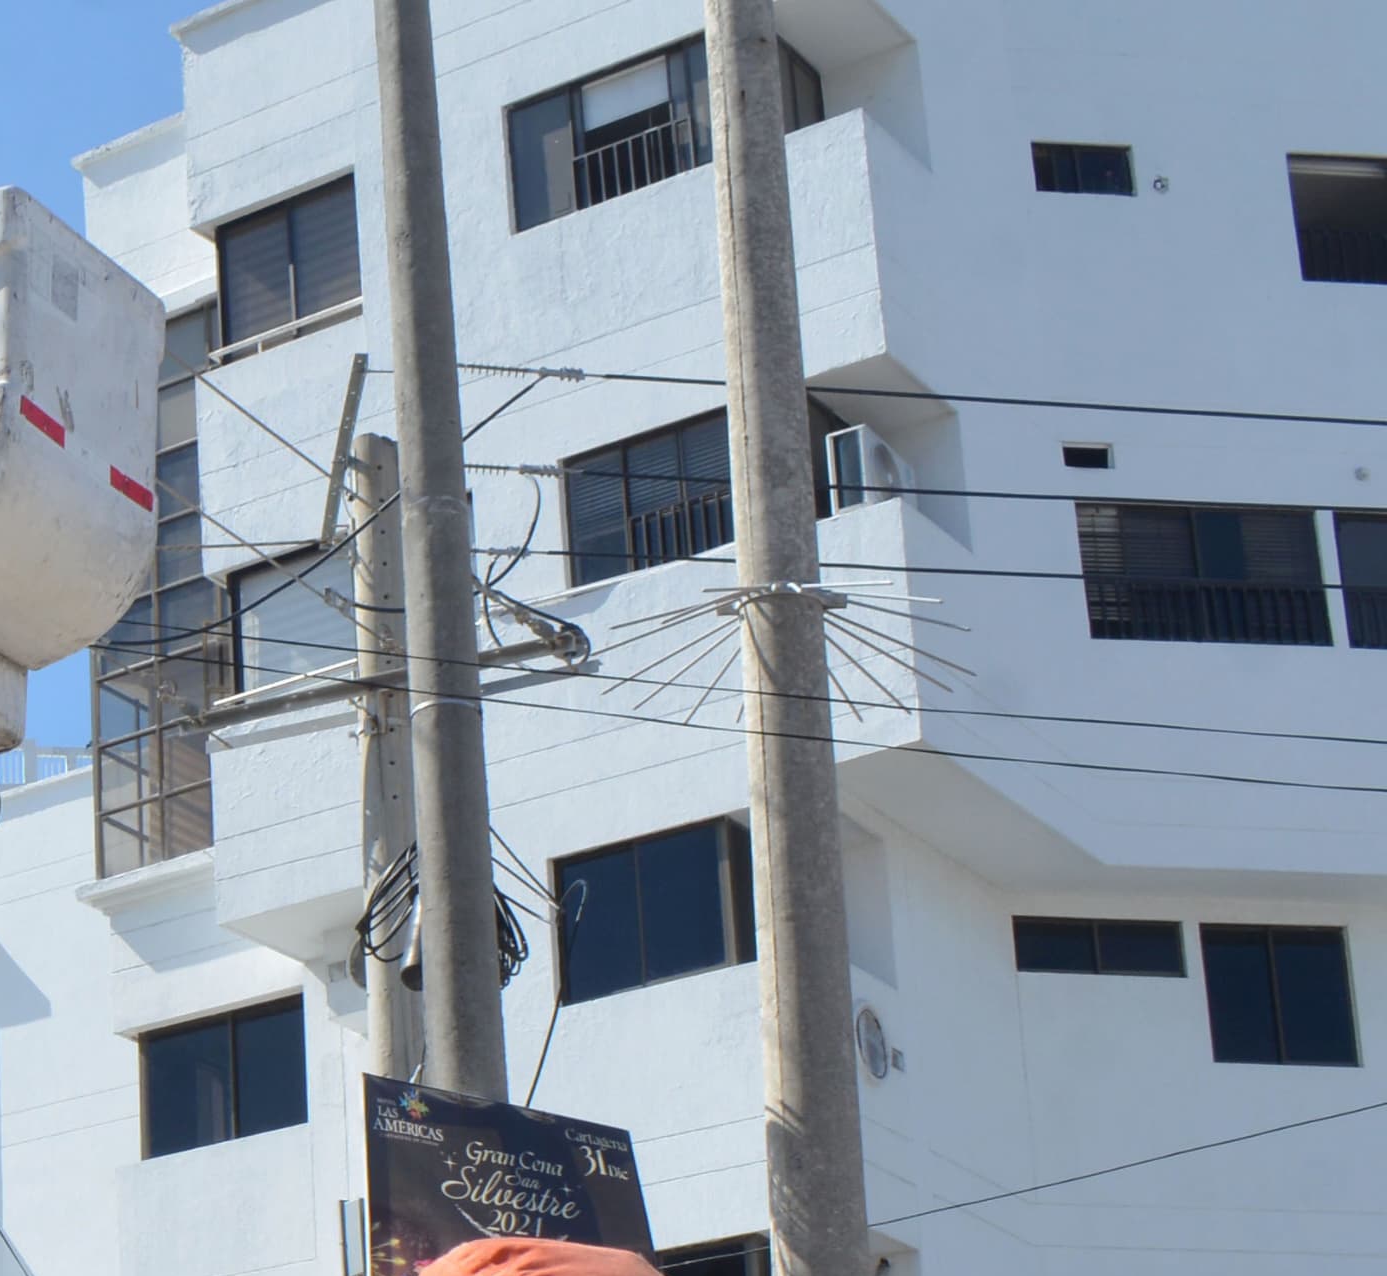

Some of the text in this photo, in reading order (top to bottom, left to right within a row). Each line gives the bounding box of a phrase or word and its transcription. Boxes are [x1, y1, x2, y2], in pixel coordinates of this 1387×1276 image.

[378, 1105, 399, 1119] LAS
[565, 1127, 628, 1152] Cartagena
[466, 1141, 564, 1177] Gran Cena
[579, 1145, 607, 1177] 31
[441, 1165, 582, 1219] Silvestre
[505, 1168, 540, 1190] San
